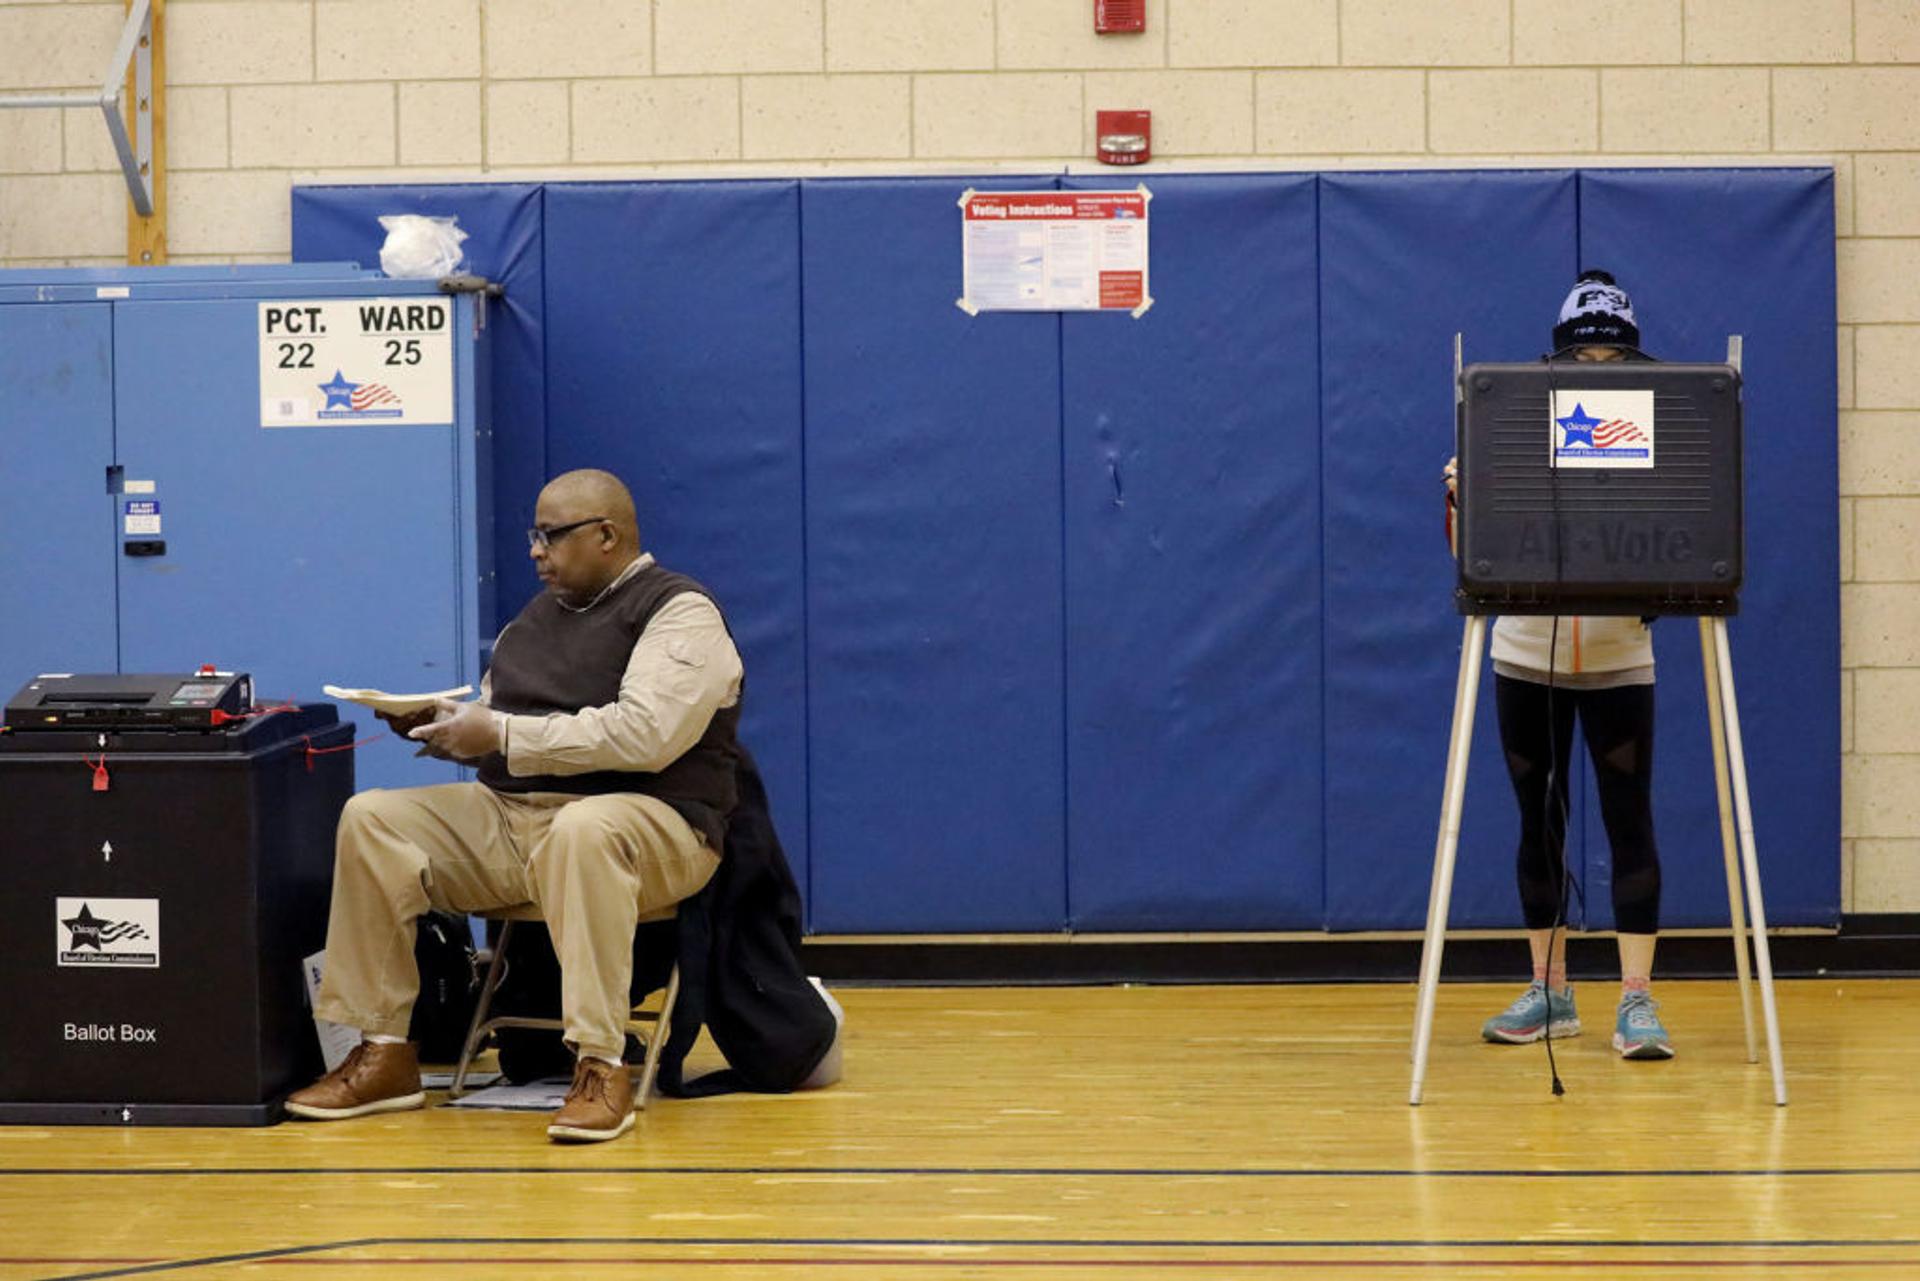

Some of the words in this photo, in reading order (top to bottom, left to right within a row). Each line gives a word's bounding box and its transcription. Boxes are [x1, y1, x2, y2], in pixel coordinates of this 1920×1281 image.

[972, 203, 1007, 218] Voting
[1008, 203, 1073, 216] Instructions
[267, 308, 326, 333] PCT.
[360, 306, 445, 331] WARD
[279, 343, 315, 368] 22
[386, 340, 422, 365] 25
[1566, 422, 1593, 433] Chicago
[1600, 523, 1694, 564] Vote
[72, 924, 99, 938] Chicago
[64, 1023, 115, 1041] Ballot
[121, 1023, 156, 1042] Box
